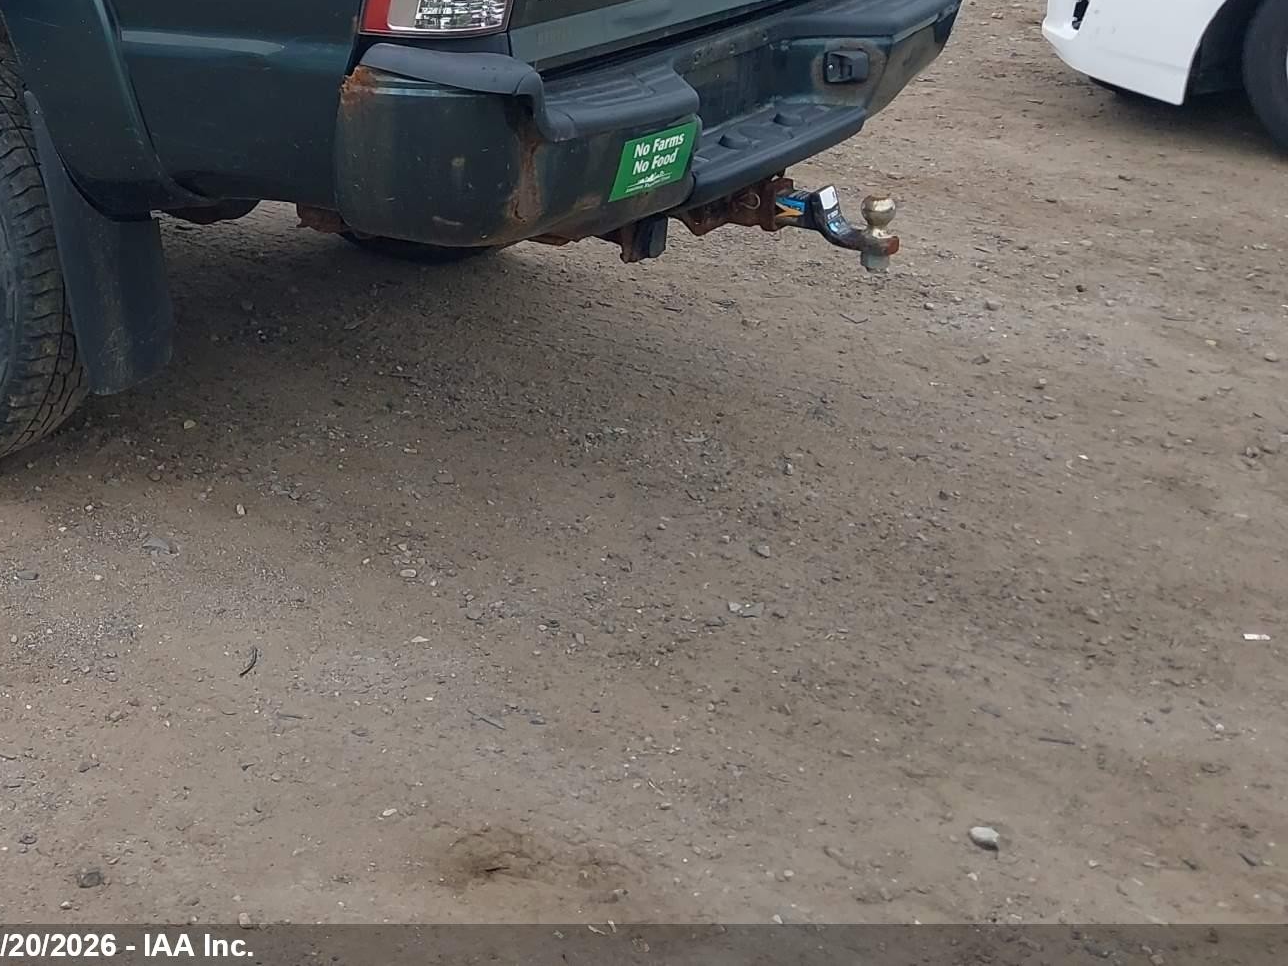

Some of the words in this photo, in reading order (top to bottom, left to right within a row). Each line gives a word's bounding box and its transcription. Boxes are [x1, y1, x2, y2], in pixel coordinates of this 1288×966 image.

[633, 142, 650, 158] No
[652, 133, 685, 153] Farms
[632, 160, 649, 175] No
[651, 147, 679, 169] Food
